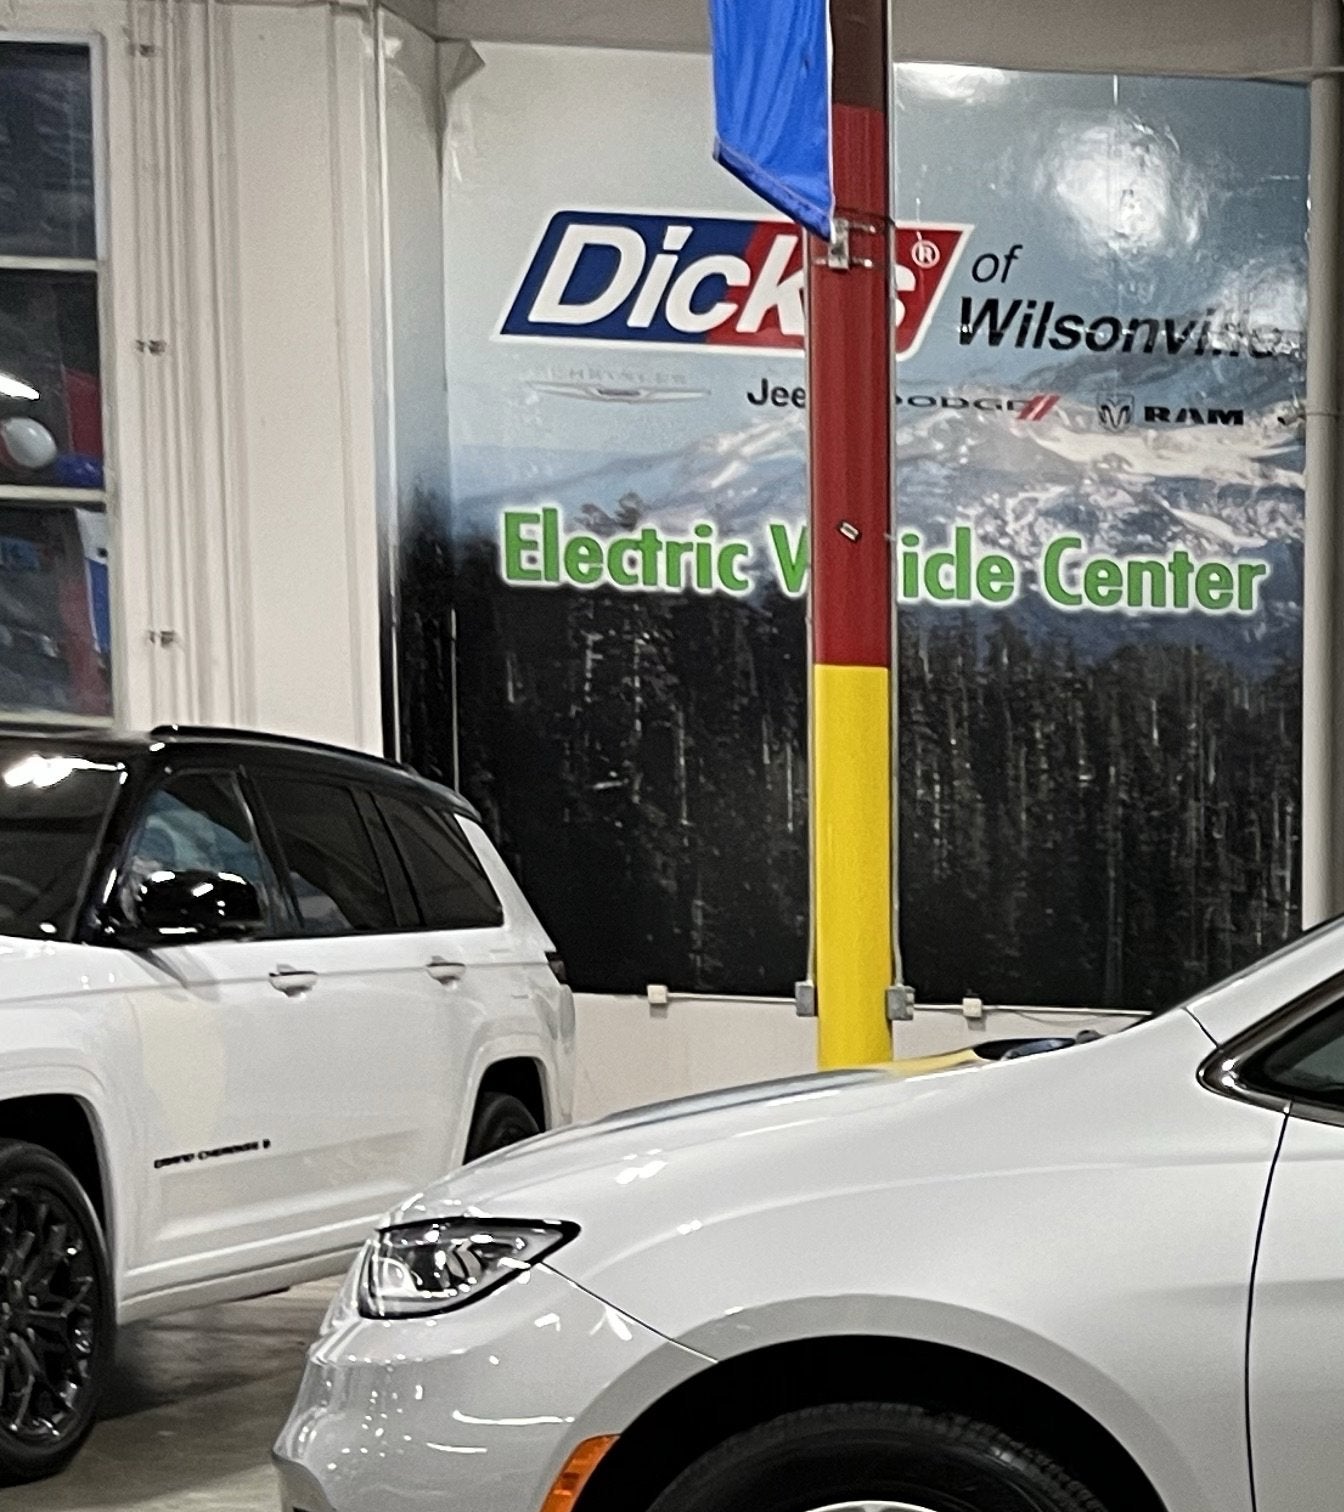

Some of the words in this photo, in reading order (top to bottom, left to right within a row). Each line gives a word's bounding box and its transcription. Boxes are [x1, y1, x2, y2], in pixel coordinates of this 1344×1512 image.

[971, 244, 1023, 283] of
[746, 378, 806, 408] Jee
[1144, 405, 1245, 426] RAM
[504, 507, 749, 591] Electric
[769, 523, 1015, 602] Vicle
[1043, 536, 1267, 611] Center
